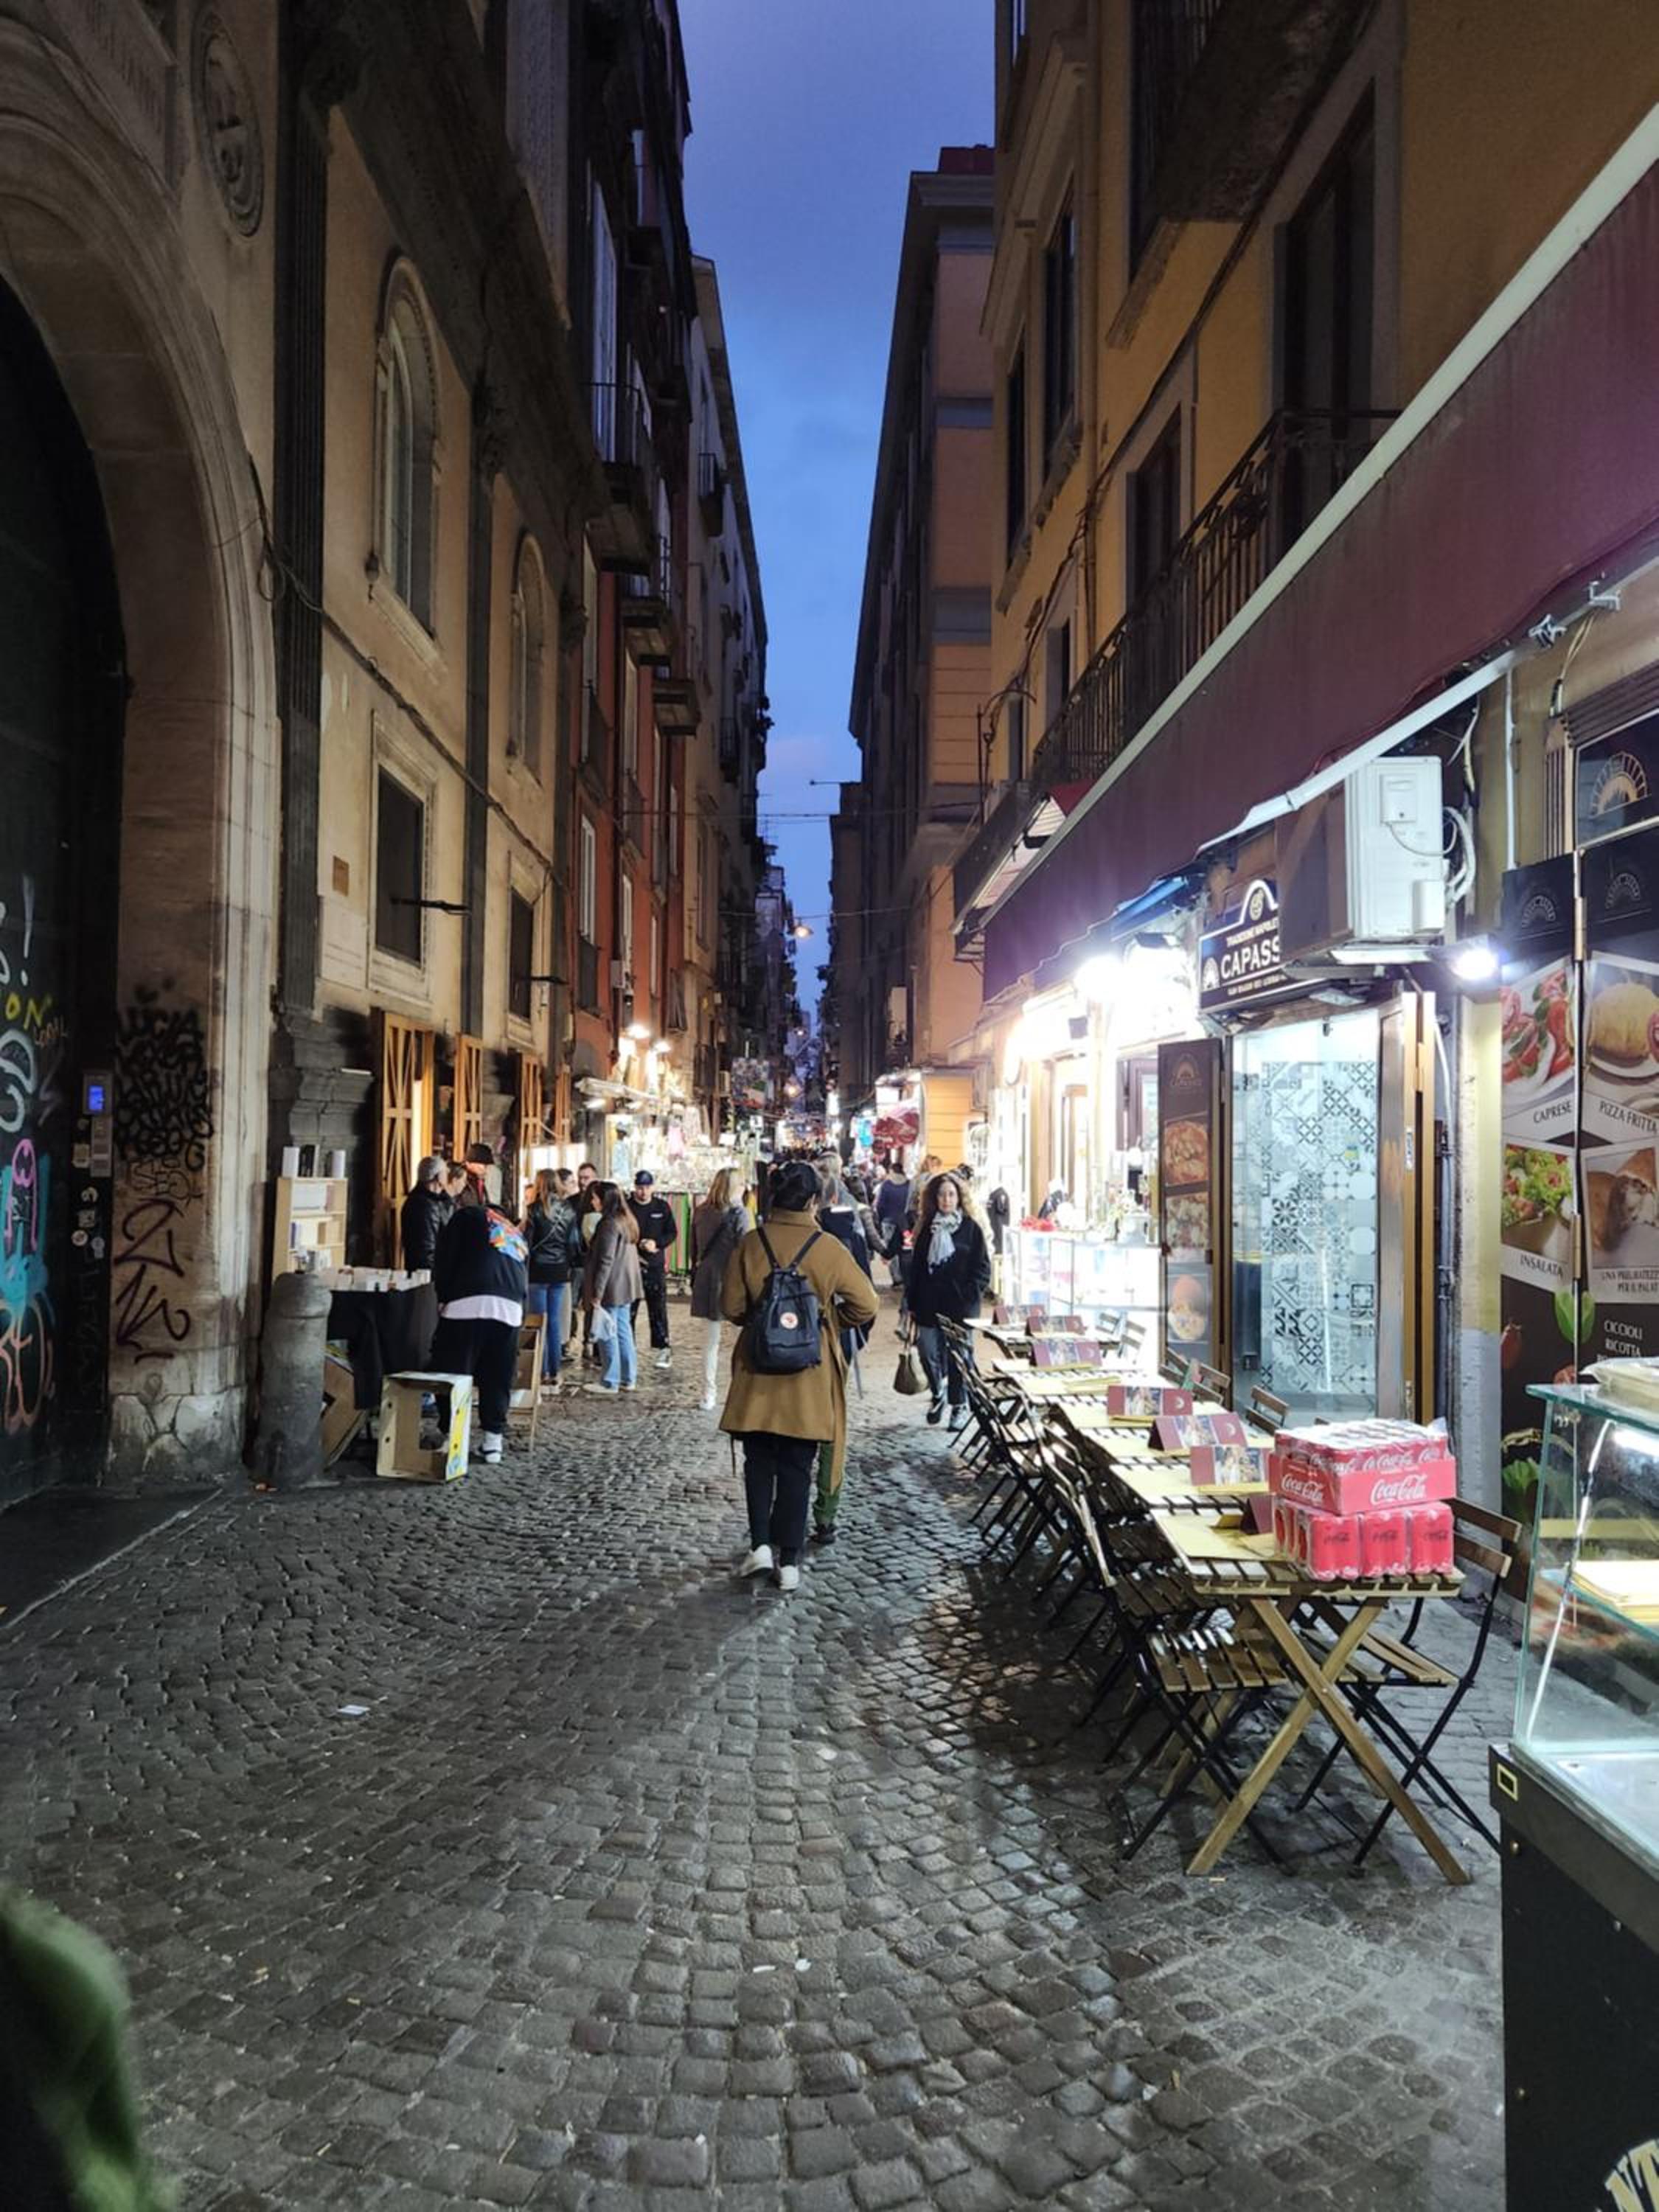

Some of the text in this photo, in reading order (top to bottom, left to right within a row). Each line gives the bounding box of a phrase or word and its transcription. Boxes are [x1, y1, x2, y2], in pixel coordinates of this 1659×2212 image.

[1533, 1099, 1572, 1124] CAPRESE
[1599, 1101, 1658, 1133] PIZZA FRITTA
[1520, 1255, 1564, 1279] INSALATA
[1604, 1320, 1643, 1340] CICCIOLI
[1604, 1338, 1641, 1357] RICOTTA
[1370, 1472, 1427, 1506] Coca-Cola
